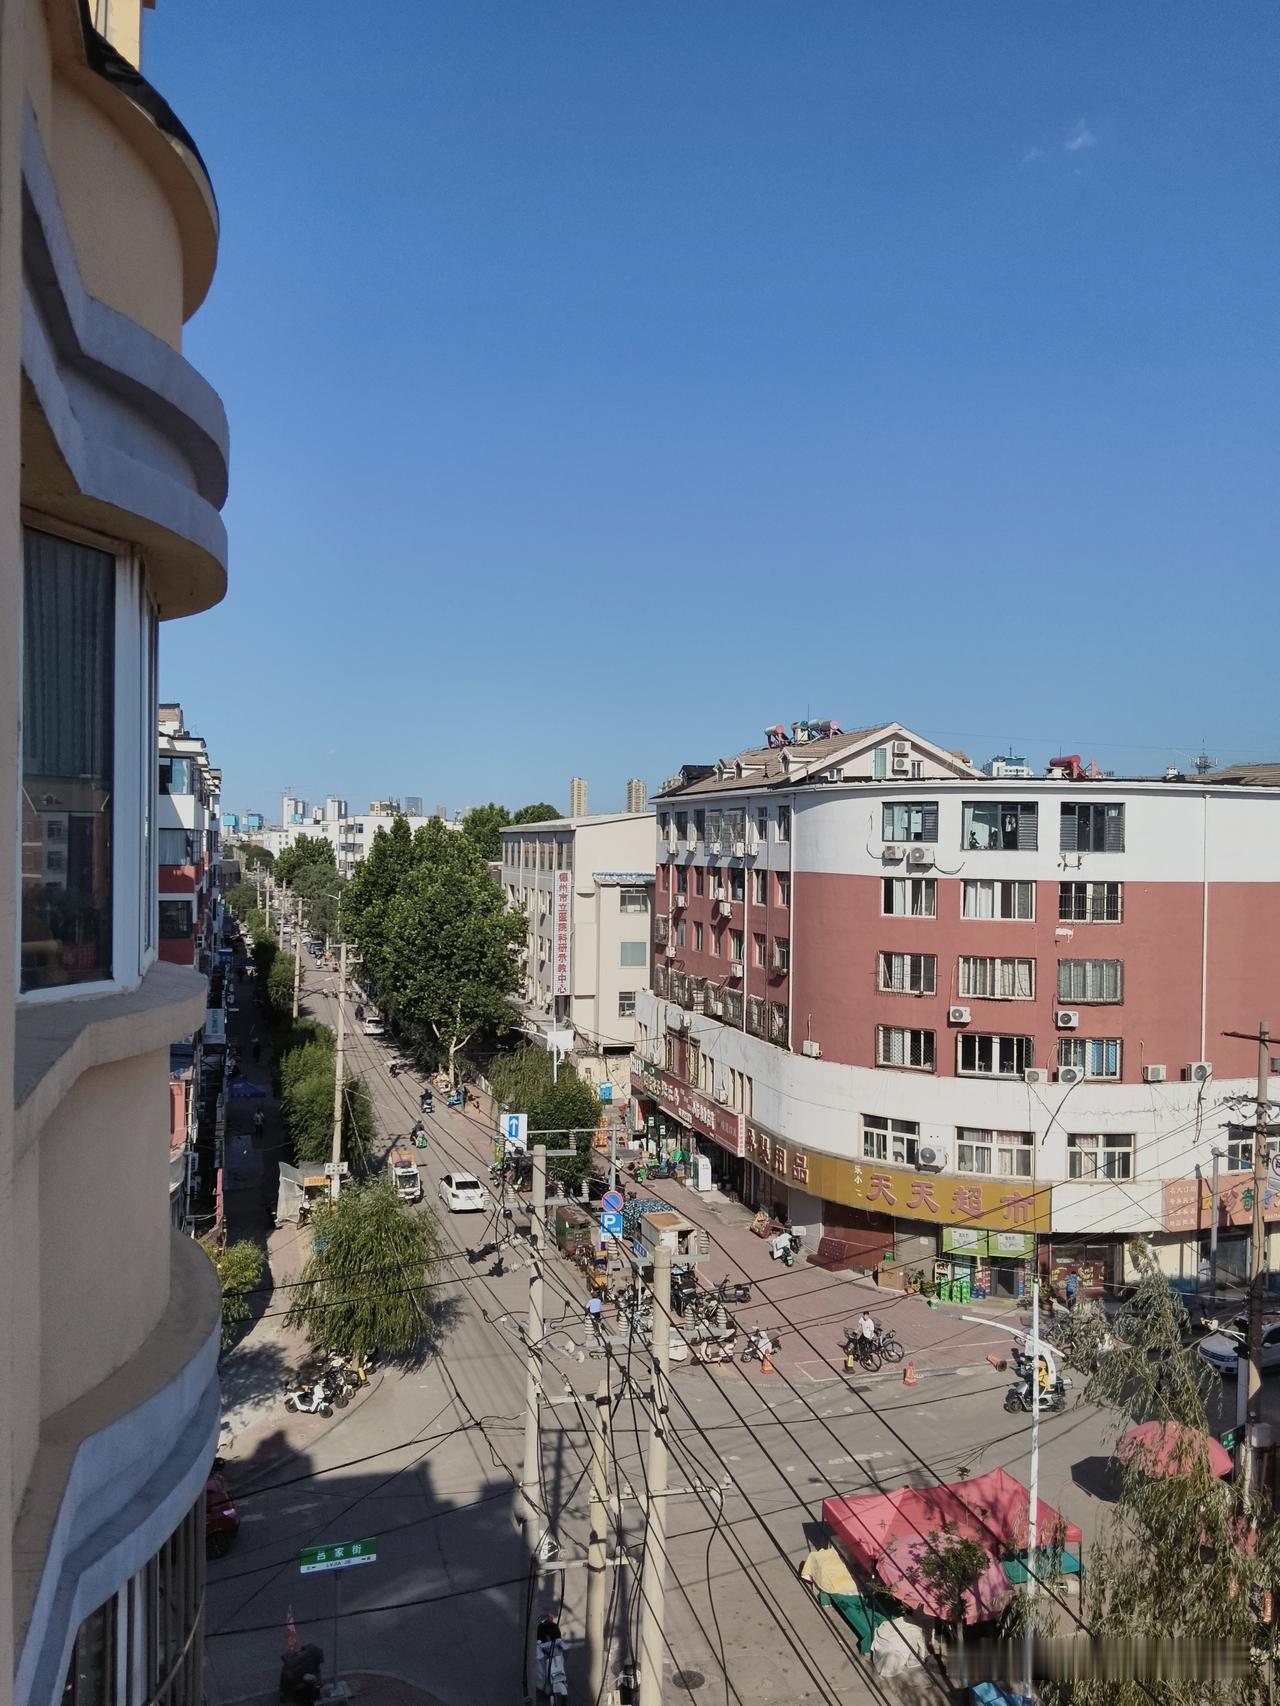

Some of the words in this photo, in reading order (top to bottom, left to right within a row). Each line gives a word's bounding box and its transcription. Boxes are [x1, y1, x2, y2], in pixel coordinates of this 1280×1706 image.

[865, 1172, 1036, 1223] 天天超市
[604, 1215, 616, 1231] P
[317, 1544, 362, 1561] 吕家街
